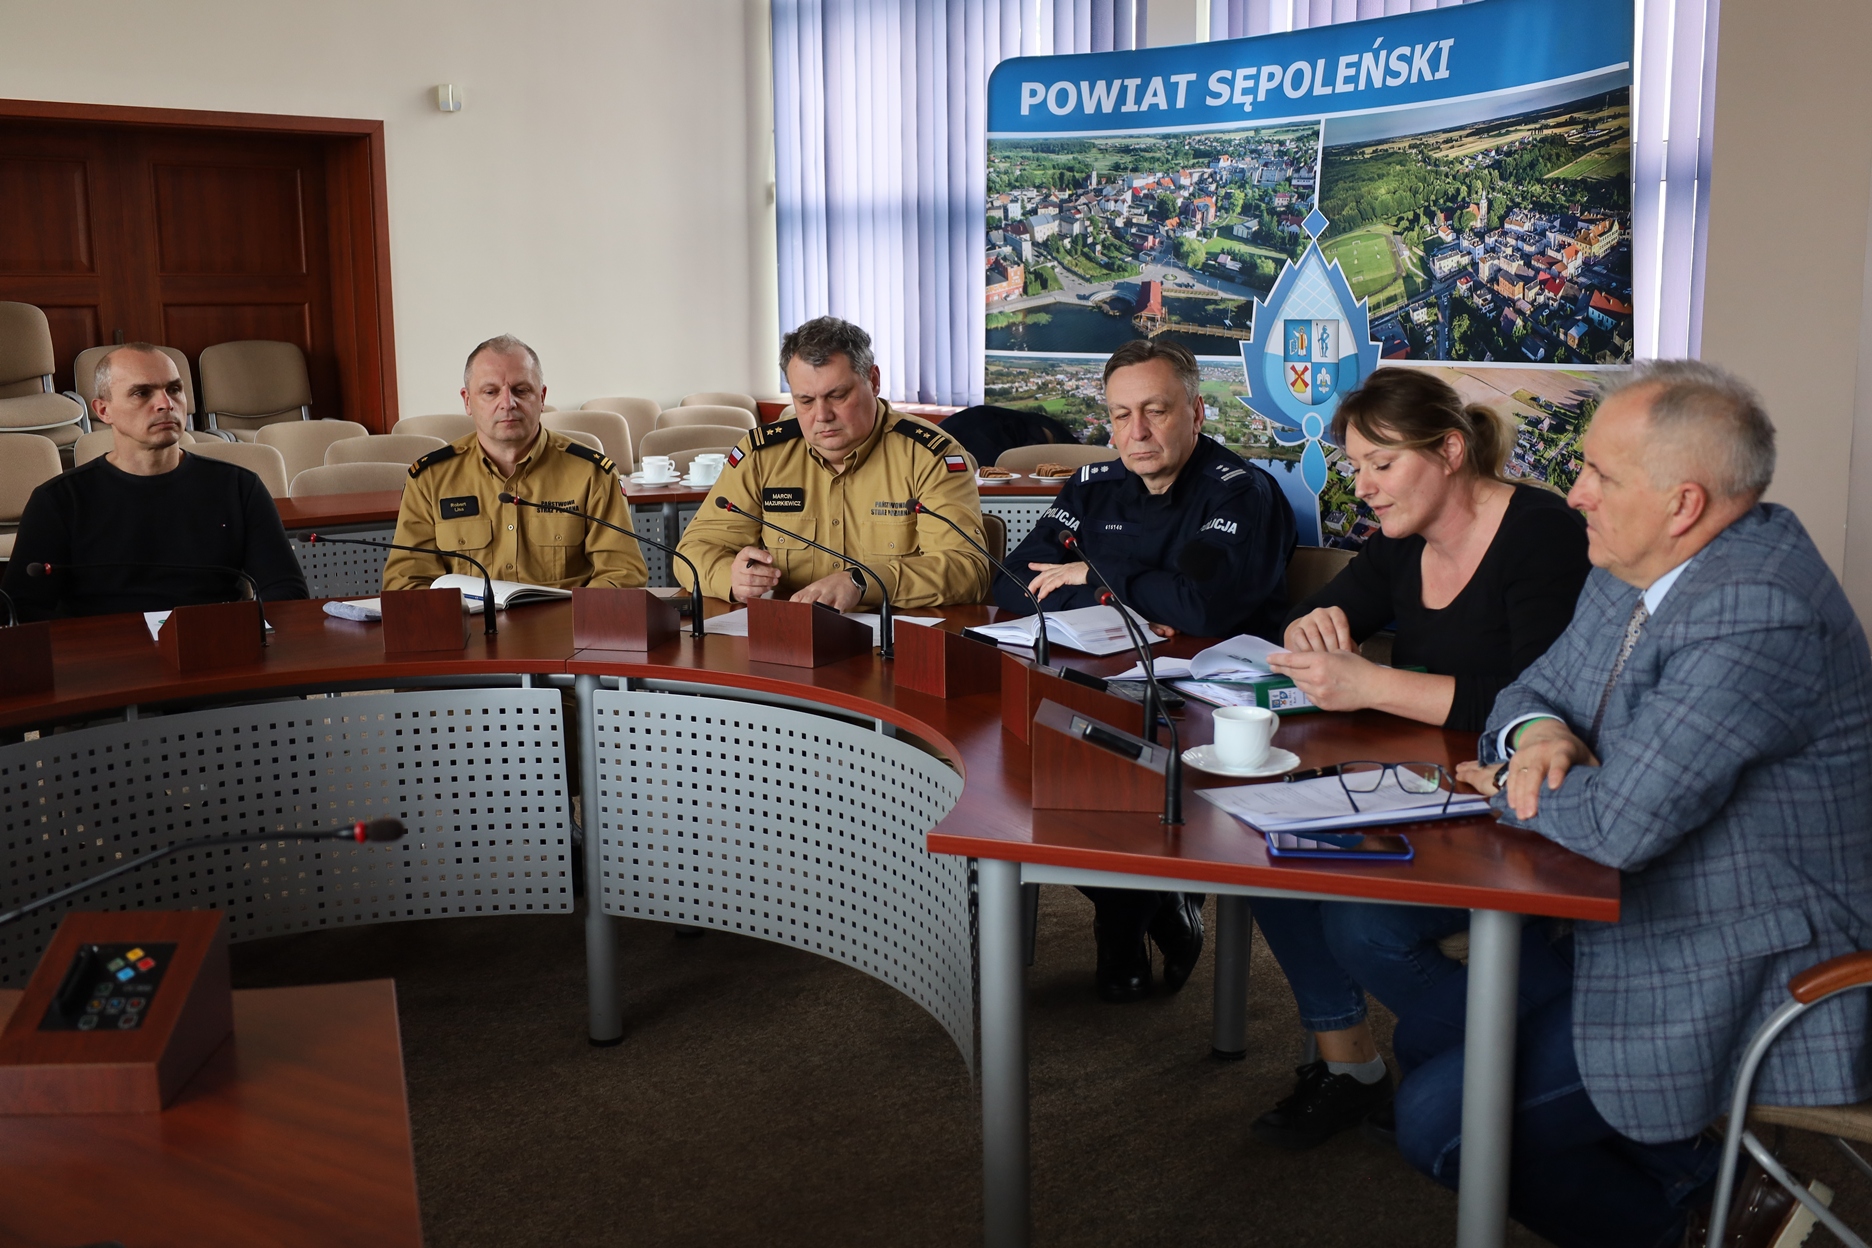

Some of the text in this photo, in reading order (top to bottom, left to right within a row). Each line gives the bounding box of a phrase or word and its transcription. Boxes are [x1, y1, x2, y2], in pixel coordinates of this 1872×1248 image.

[1020, 37, 1455, 116] POWIAT SĘPOLEŃSKI
[1043, 507, 1081, 532] POLICJA
